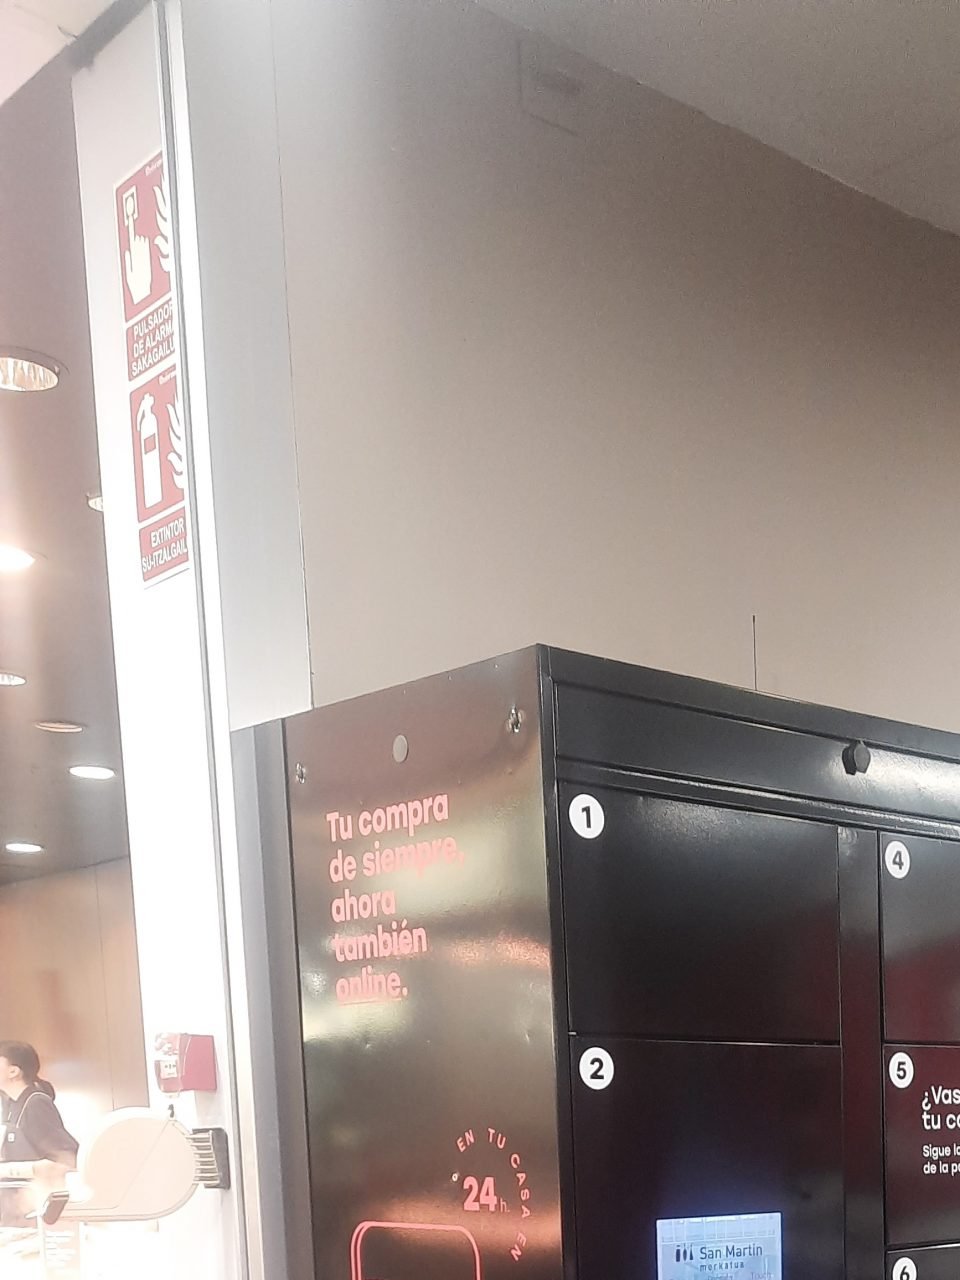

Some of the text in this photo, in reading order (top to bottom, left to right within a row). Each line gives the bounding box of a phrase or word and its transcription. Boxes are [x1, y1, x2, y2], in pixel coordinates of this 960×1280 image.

[133, 319, 174, 358] DE ALARM
[151, 517, 184, 548] EXTINTOR
[326, 793, 449, 842] Tu compra
[581, 806, 592, 829] 1
[329, 837, 466, 883] de siempre,
[892, 851, 905, 870] 4
[331, 888, 396, 923] ahora
[331, 919, 428, 962] también
[335, 966, 408, 1005] online.
[589, 1058, 604, 1080] 2
[896, 1061, 907, 1080] 5
[922, 1111, 941, 1130] tu
[922, 1144, 951, 1160] Sigue
[457, 1129, 475, 1152] EN
[487, 1127, 507, 1149] TU
[510, 1153, 531, 1218] CASA
[923, 1160, 937, 1174] de
[939, 1160, 949, 1174] la
[699, 1243, 763, 1260] San Martin
